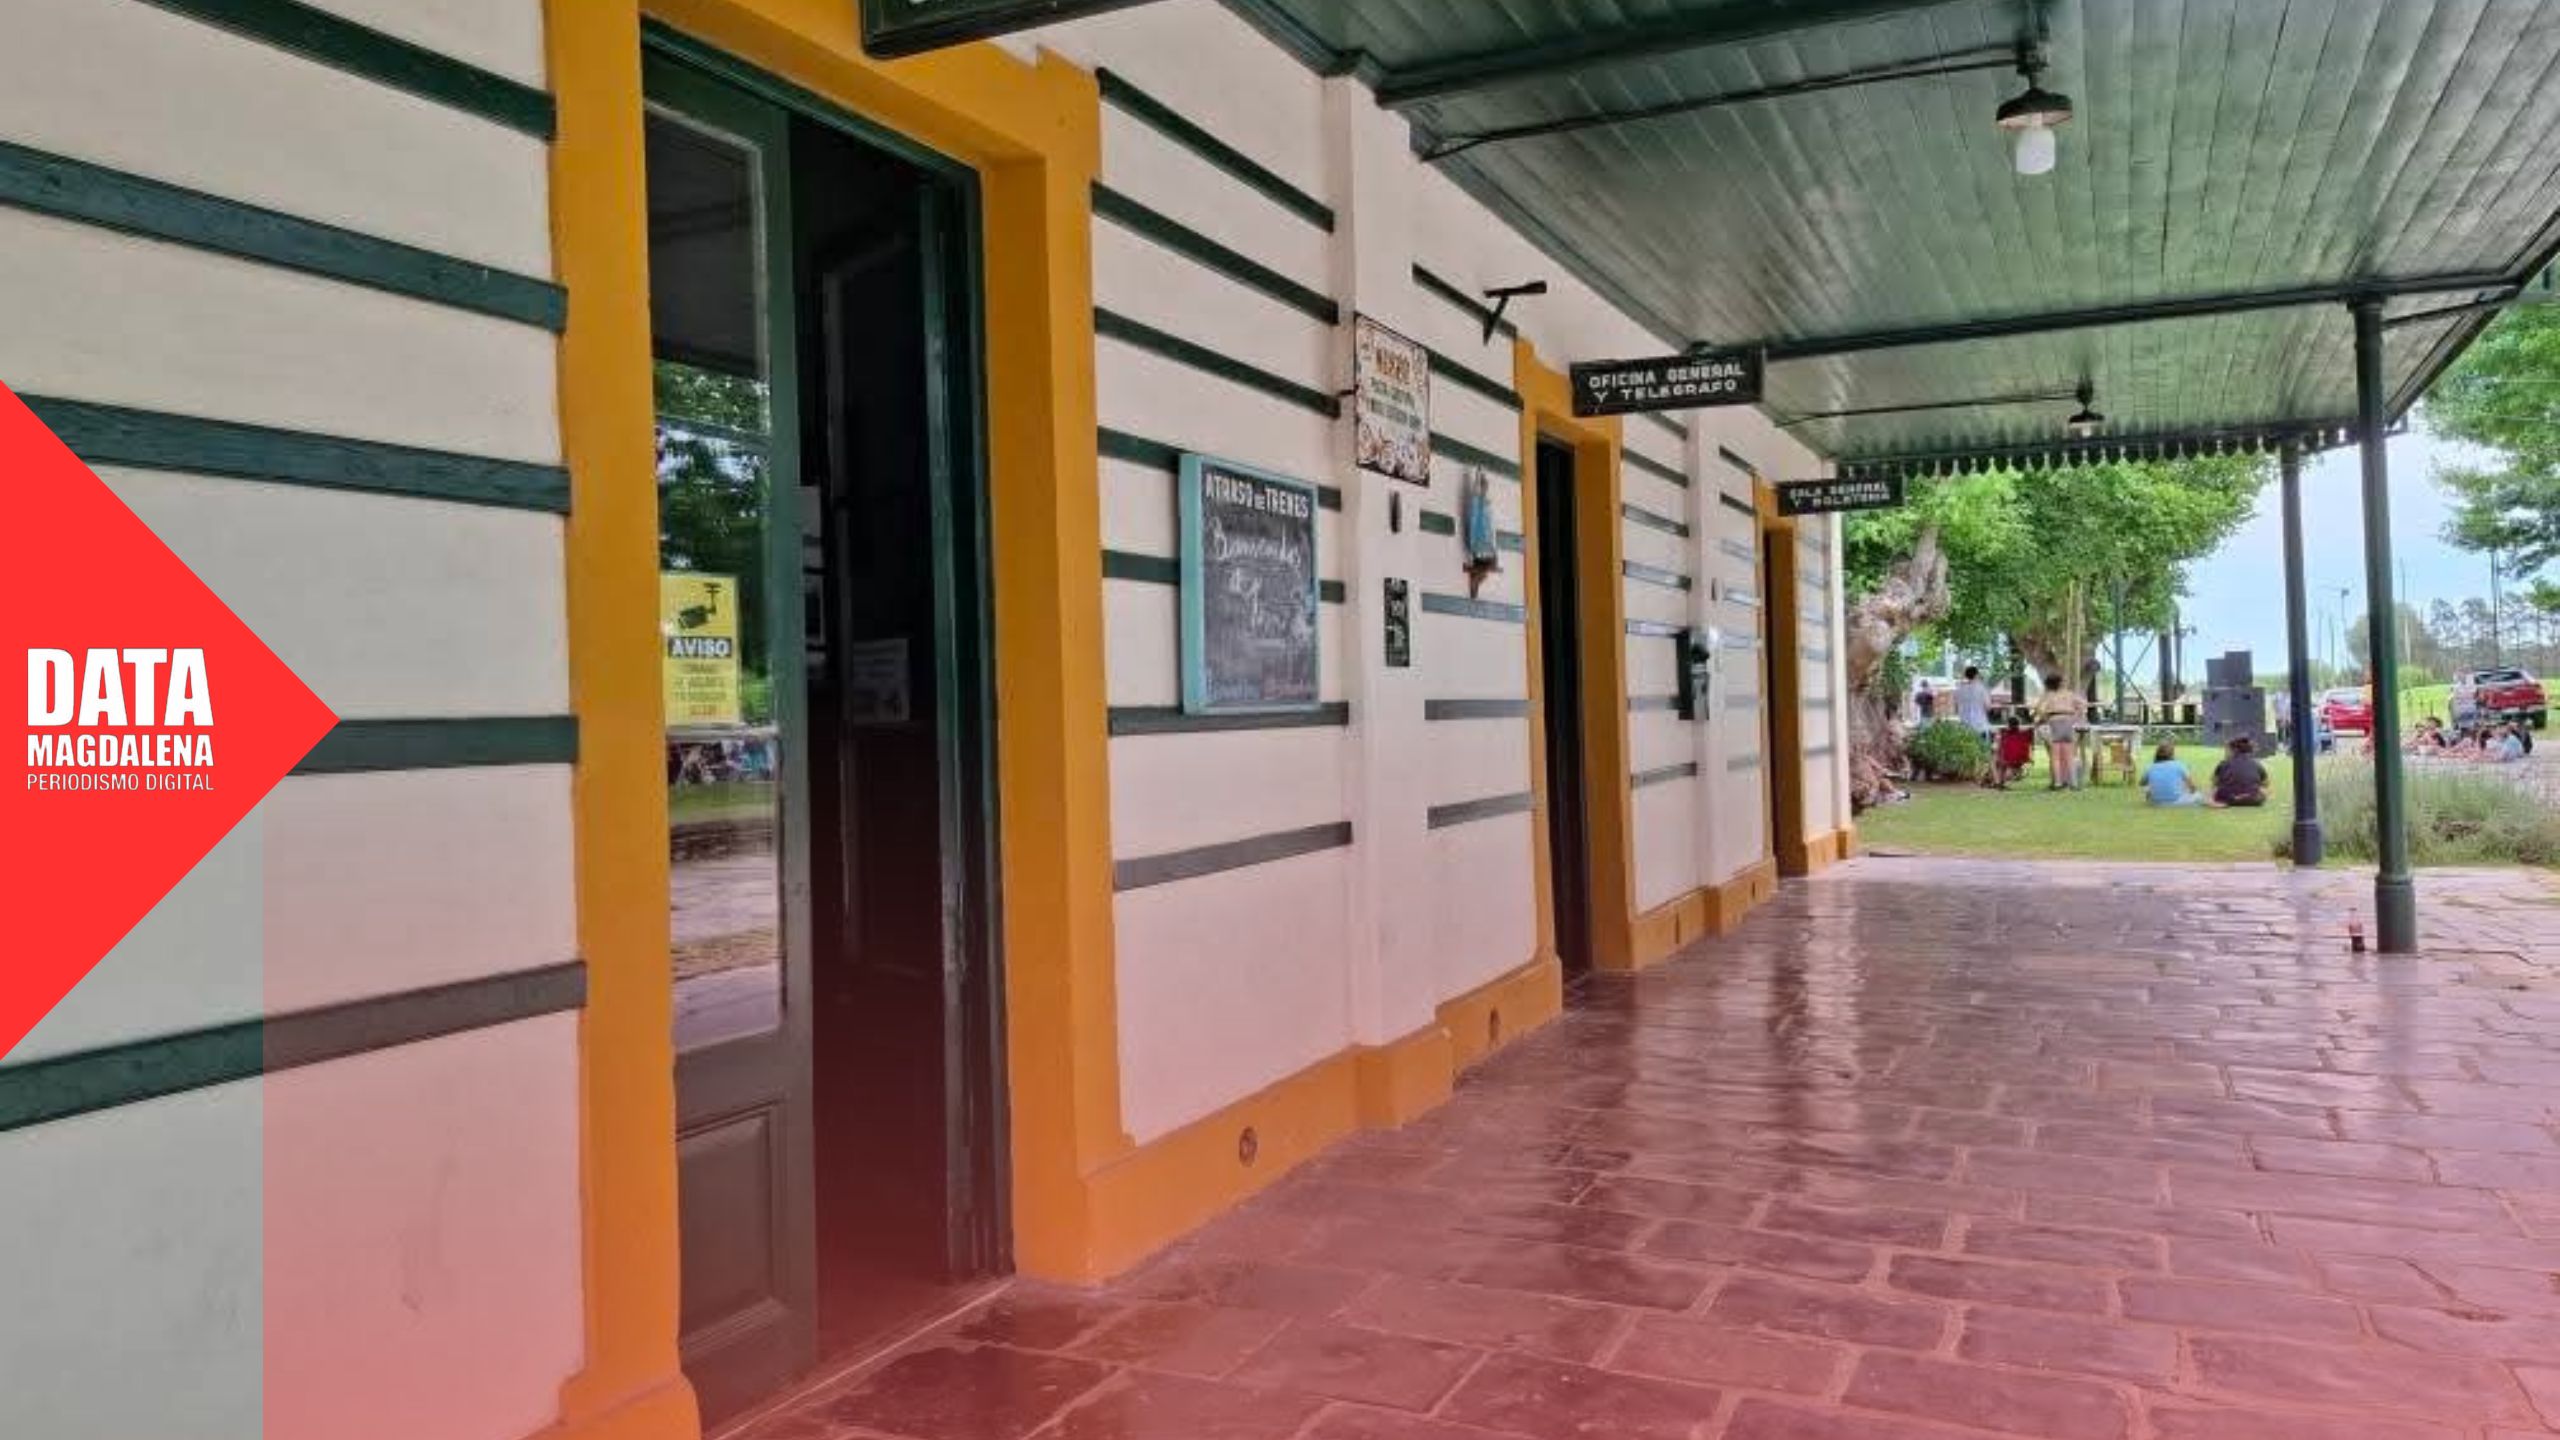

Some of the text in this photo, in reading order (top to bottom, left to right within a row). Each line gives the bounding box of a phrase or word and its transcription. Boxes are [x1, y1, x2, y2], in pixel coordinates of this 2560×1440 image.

[1589, 363, 1746, 389] OFICINA GENERAL
[1594, 379, 1737, 403] Y TELEGRAFO
[1206, 472, 1253, 508] ATRASO
[1264, 485, 1309, 518] TRENES
[672, 638, 730, 657] AVISO
